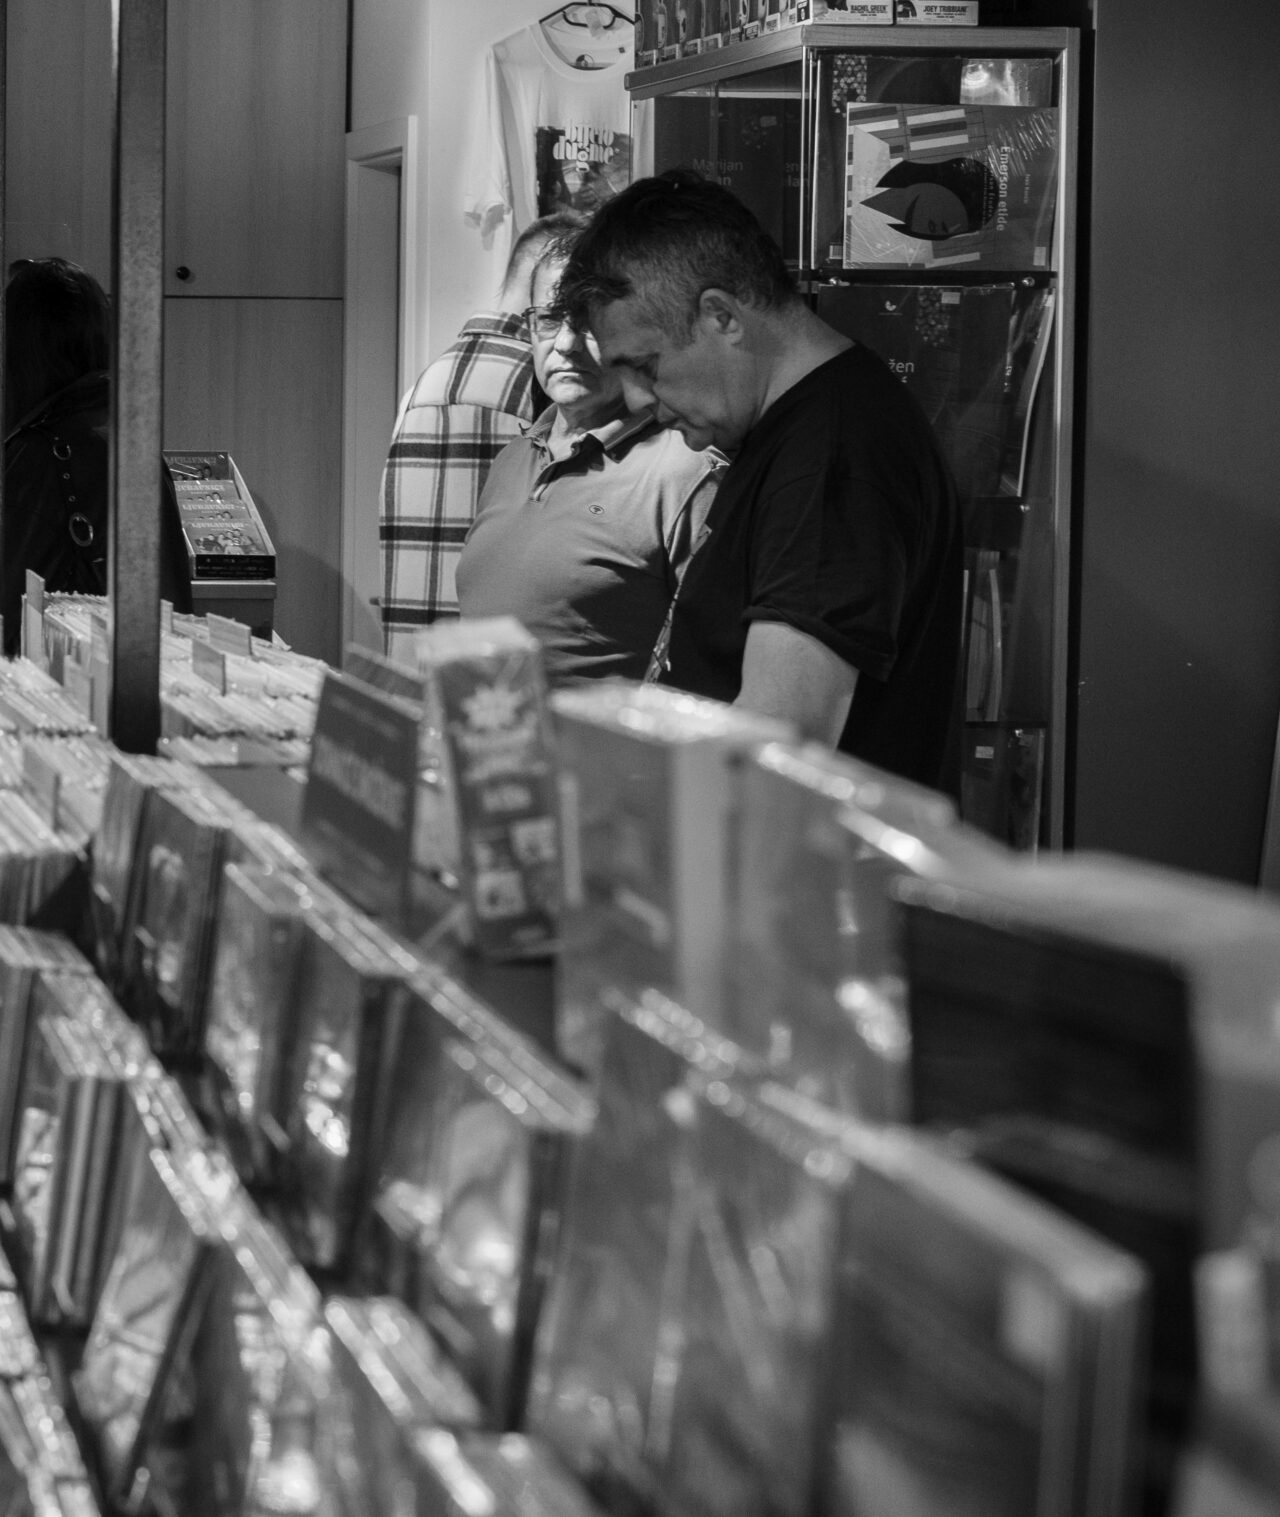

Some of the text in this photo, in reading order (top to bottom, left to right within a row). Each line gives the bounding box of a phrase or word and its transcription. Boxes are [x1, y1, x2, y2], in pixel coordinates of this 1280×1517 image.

[552, 135, 615, 173] dugme
[996, 146, 1010, 231] Emerson etide
